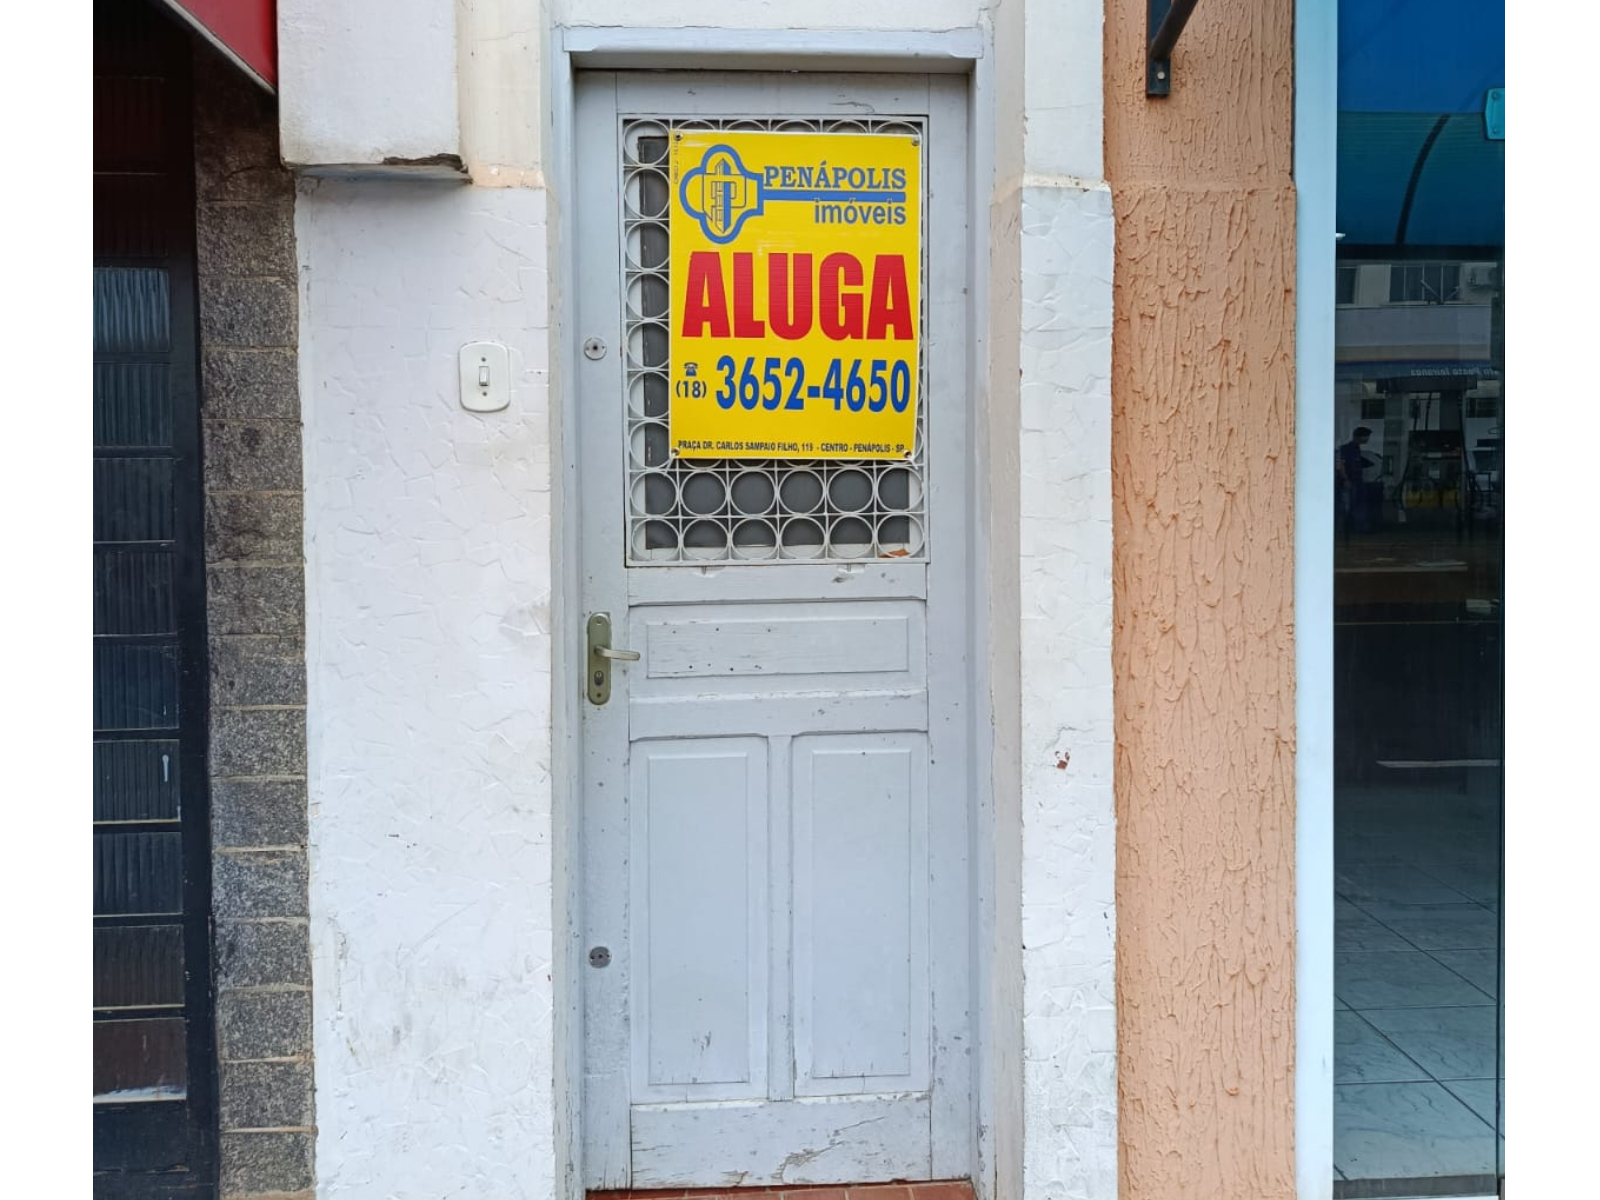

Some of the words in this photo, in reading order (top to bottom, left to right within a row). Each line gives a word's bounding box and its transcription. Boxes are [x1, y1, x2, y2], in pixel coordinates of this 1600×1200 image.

[763, 160, 906, 189] PENÁPOLIS
[814, 197, 906, 224] imóveis
[682, 251, 914, 341] ALUGA
[676, 380, 707, 399] (18)
[716, 355, 911, 413] 3652-4650
[678, 440, 701, 452] PRAÇA
[703, 441, 714, 450] DR.
[716, 441, 744, 451] CARLOS
[745, 442, 776, 452] SAMPAIO
[777, 443, 800, 453] FILHO,
[820, 443, 848, 453] CENTRO
[853, 442, 891, 453] PENÁPOLIS
[896, 443, 905, 453] SP
